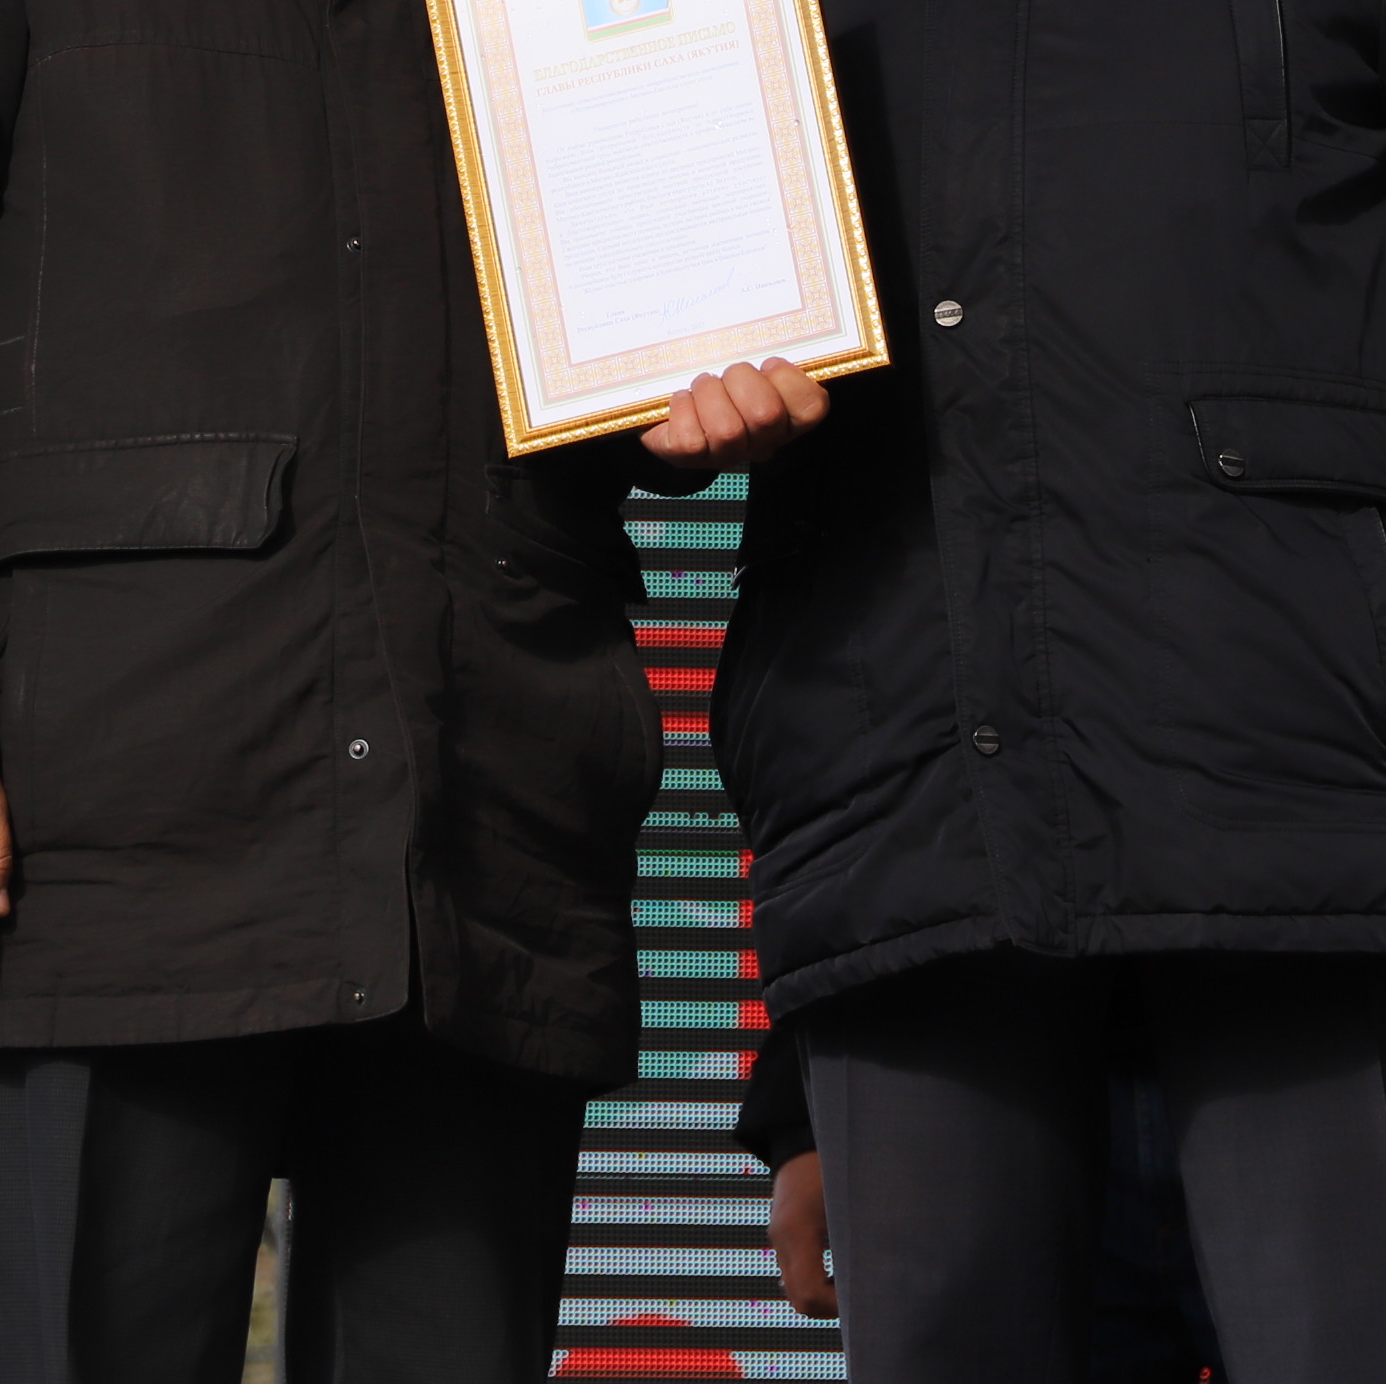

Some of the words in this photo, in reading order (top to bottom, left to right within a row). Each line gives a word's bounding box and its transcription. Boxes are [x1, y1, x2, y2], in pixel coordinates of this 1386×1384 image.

[535, 80, 575, 97] ГЛАВЫ
[577, 61, 651, 87] РЕСПУБЛИКИ
[653, 52, 684, 68] САХА
[686, 38, 739, 60] (ЯКУТИЯ)
